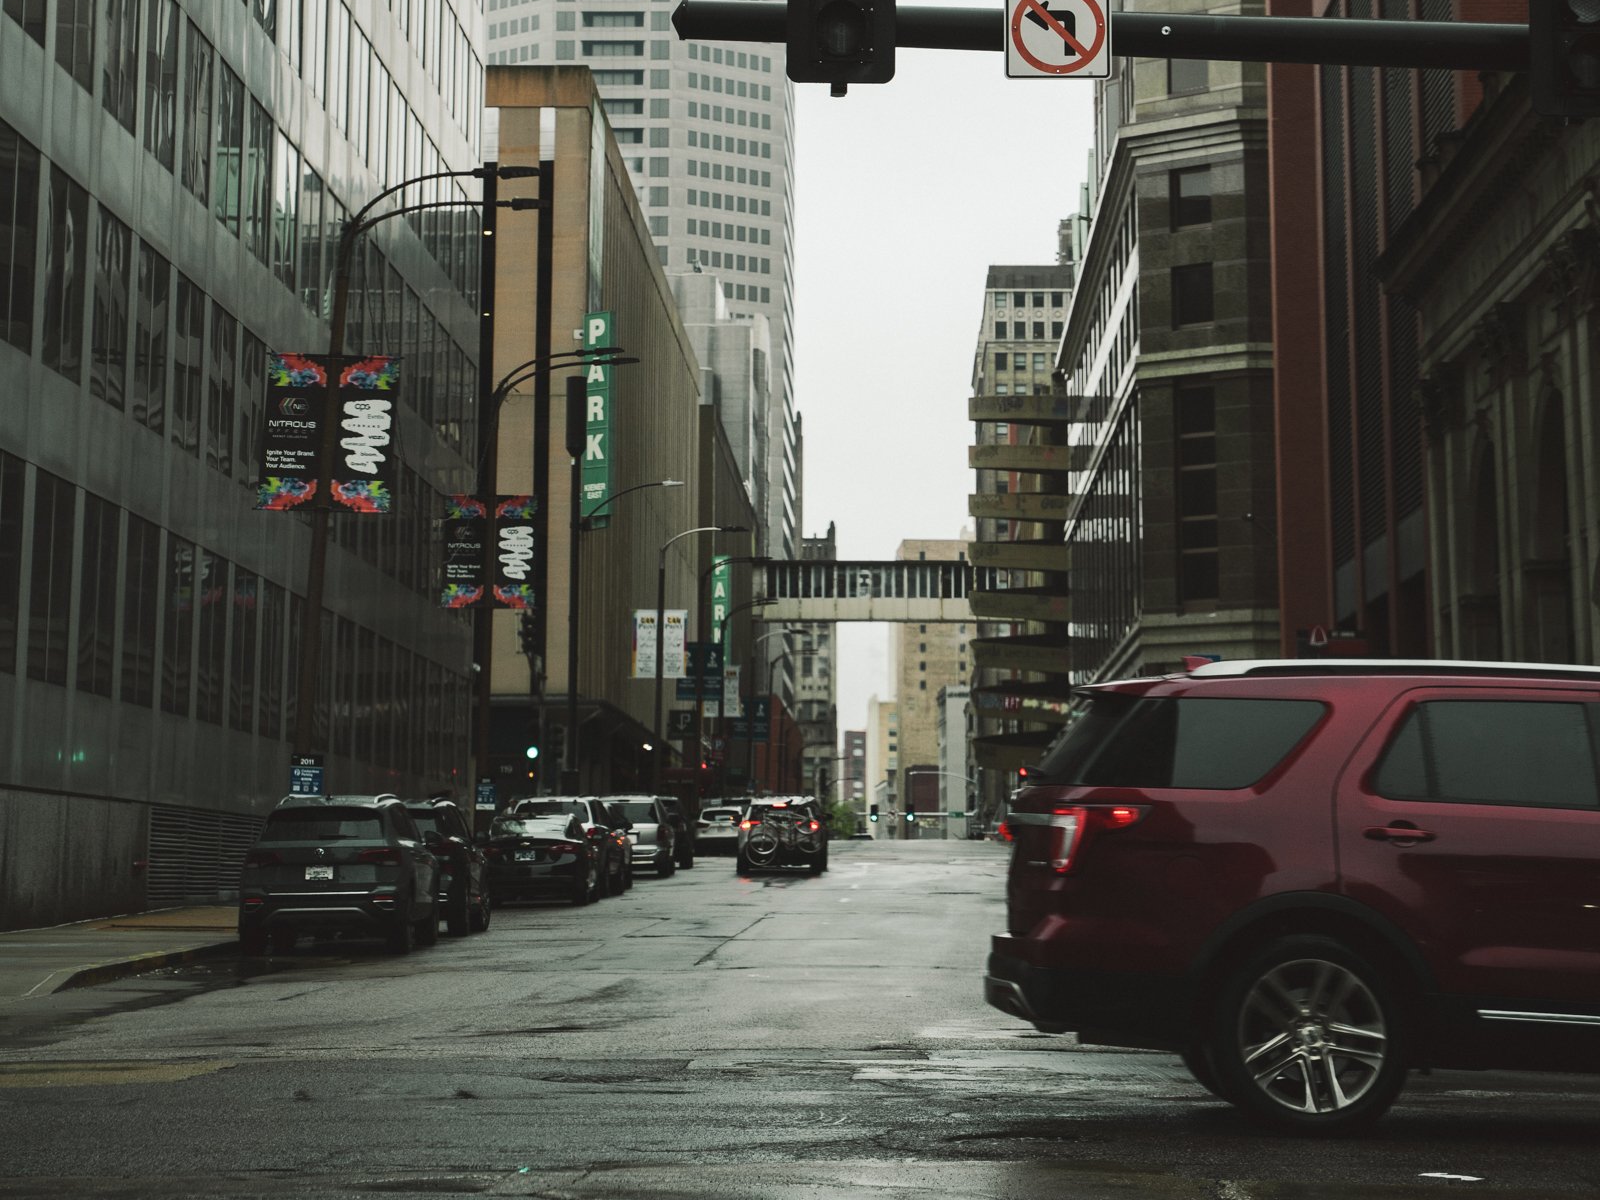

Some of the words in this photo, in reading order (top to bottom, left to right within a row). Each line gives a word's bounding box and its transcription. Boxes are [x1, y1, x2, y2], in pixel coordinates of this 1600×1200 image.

[586, 318, 606, 461] PARK
[268, 420, 316, 429] NITROUS
[583, 482, 606, 492] KIENER
[586, 490, 603, 500] EAST
